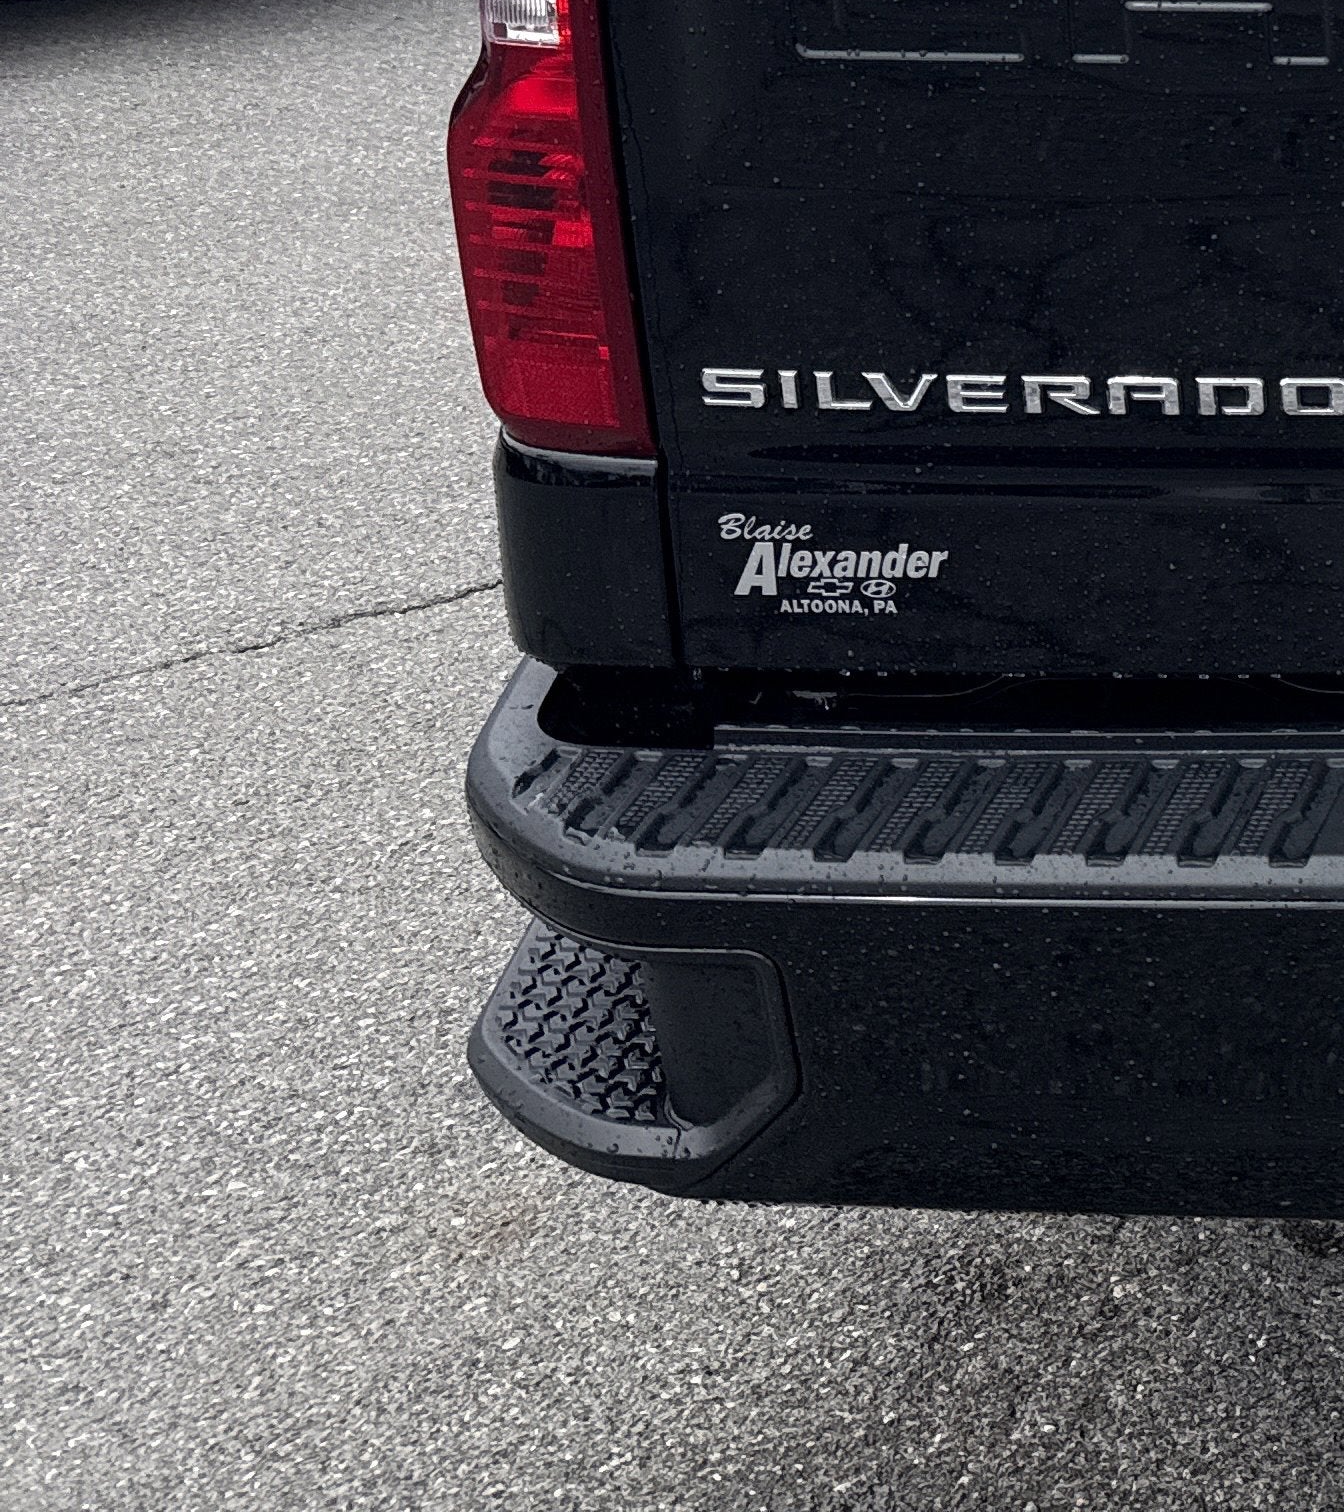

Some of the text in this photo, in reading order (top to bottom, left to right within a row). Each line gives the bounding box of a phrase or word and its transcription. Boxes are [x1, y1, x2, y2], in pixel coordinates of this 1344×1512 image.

[717, 513, 814, 540] Blaise
[734, 541, 949, 596] Alexander
[780, 599, 898, 616] ALTOONA, PA
